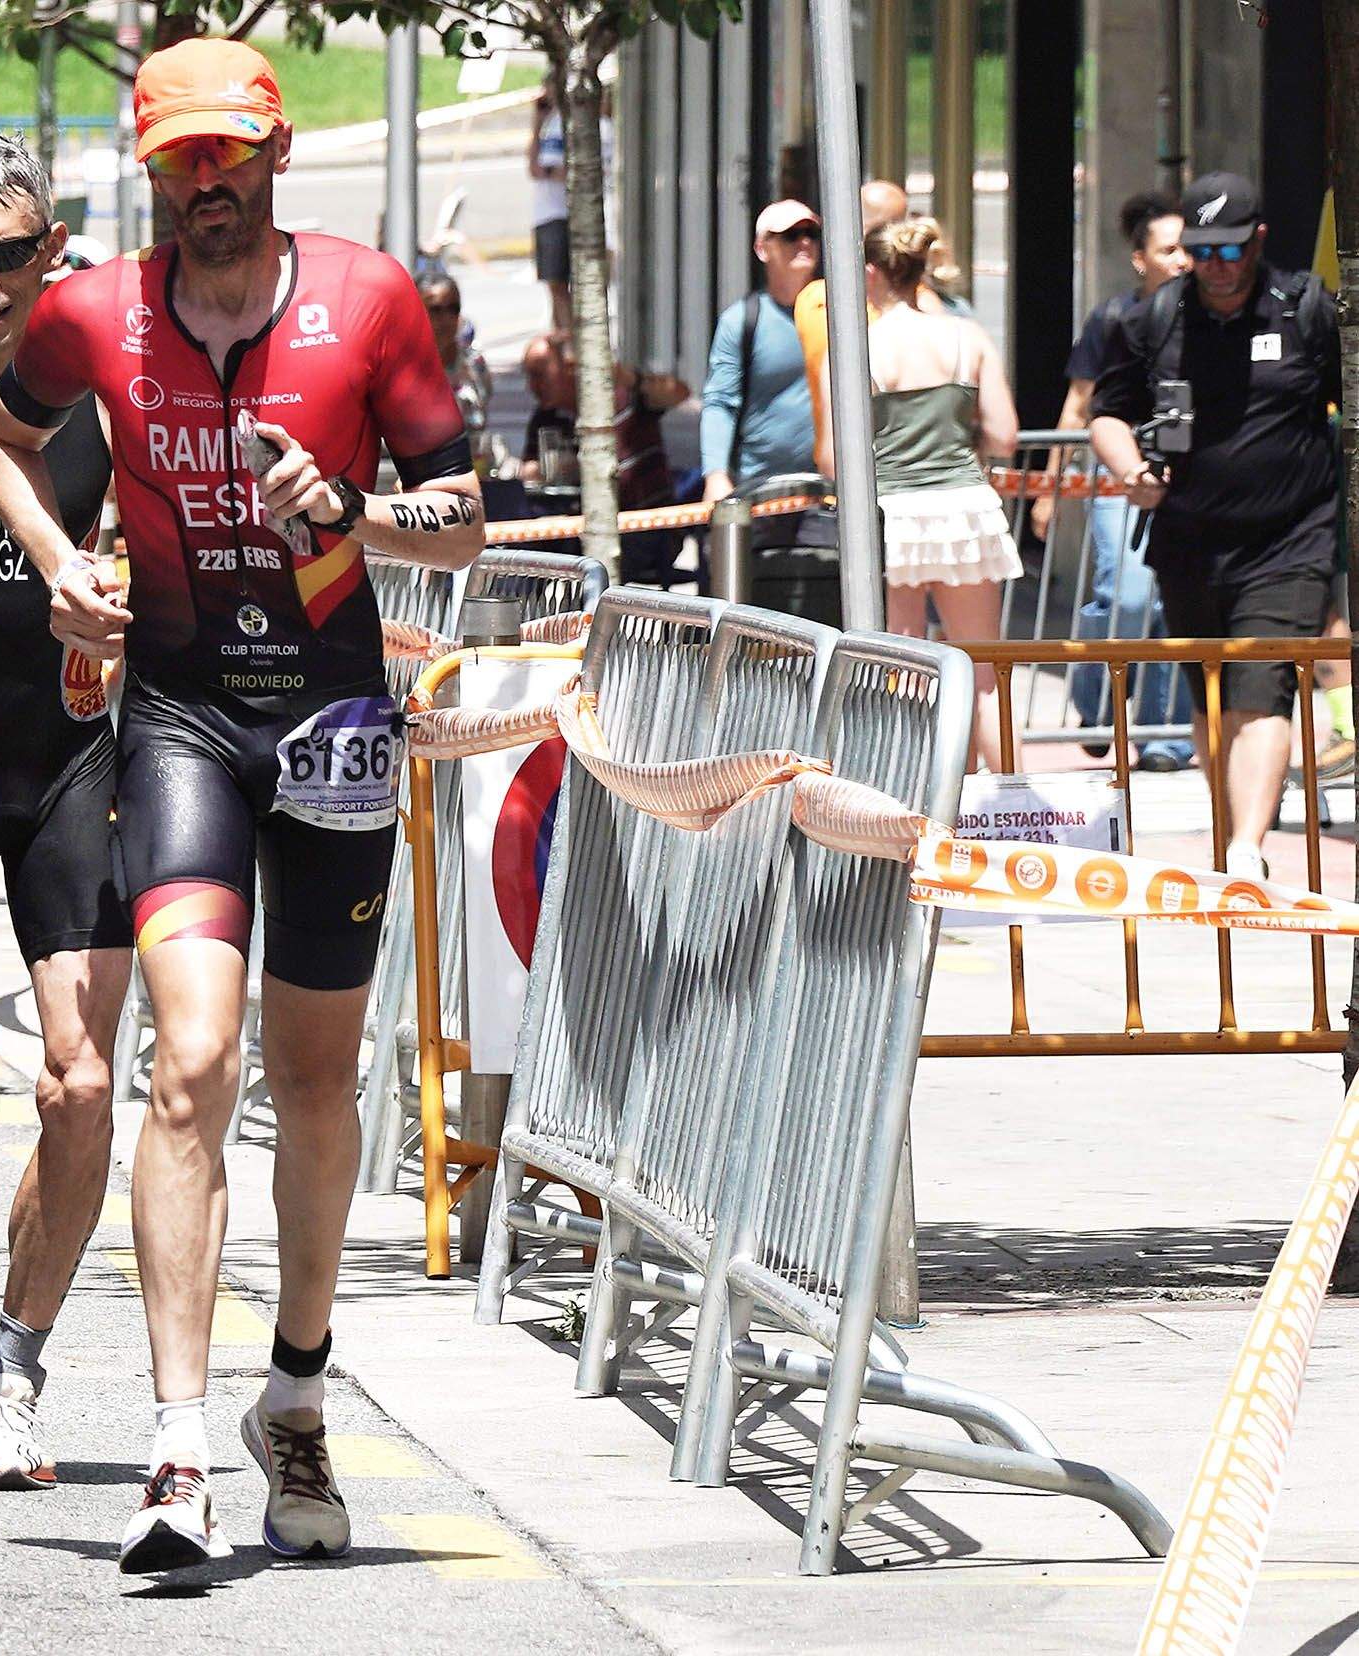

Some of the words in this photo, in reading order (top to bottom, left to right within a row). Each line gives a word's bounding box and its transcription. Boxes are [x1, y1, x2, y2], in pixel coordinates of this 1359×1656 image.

[230, 397, 248, 407] DE
[251, 392, 303, 406] MURCIA
[220, 645, 248, 656] CLUB
[250, 645, 299, 656] TRIATLON
[221, 674, 305, 689] TRIOVIEDO
[287, 734, 391, 783] 6136
[993, 811, 1087, 829] ESTACIONAR
